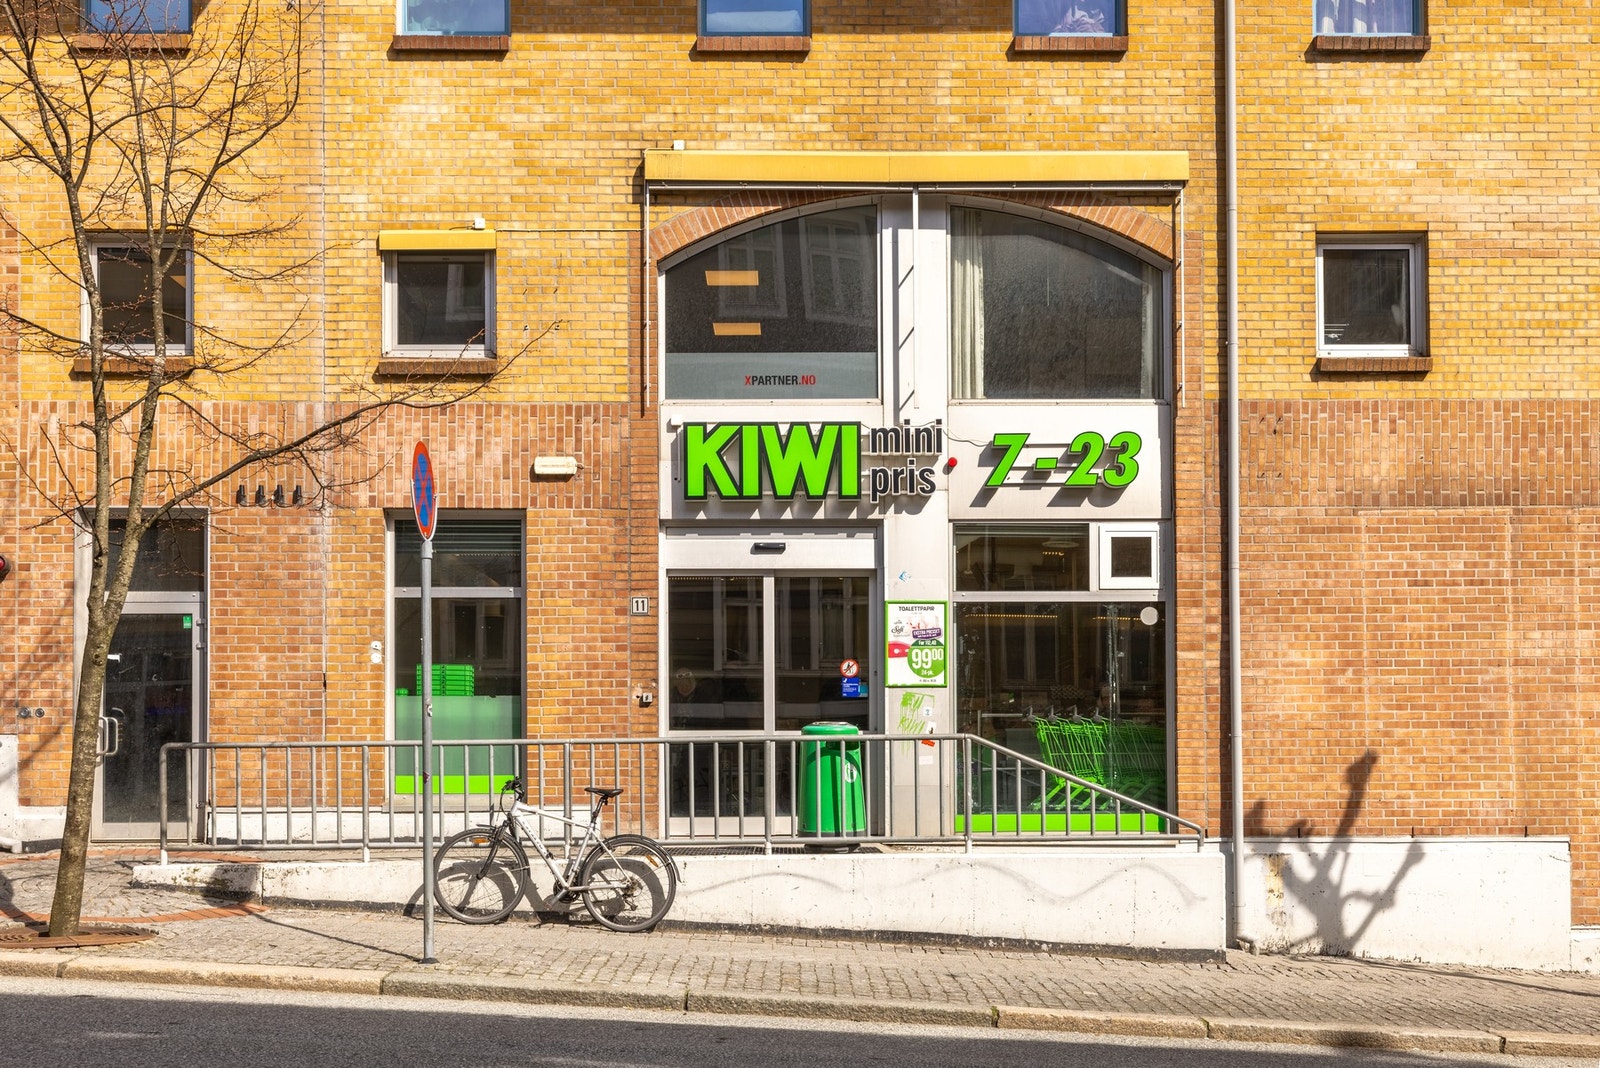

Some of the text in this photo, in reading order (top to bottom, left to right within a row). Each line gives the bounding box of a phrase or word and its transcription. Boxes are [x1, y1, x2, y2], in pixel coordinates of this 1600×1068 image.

[744, 375, 816, 386] XPARTNER.NO
[869, 419, 943, 455] mini
[683, 421, 862, 501] KIWI
[869, 458, 937, 504] pris
[635, 600, 645, 611] 11
